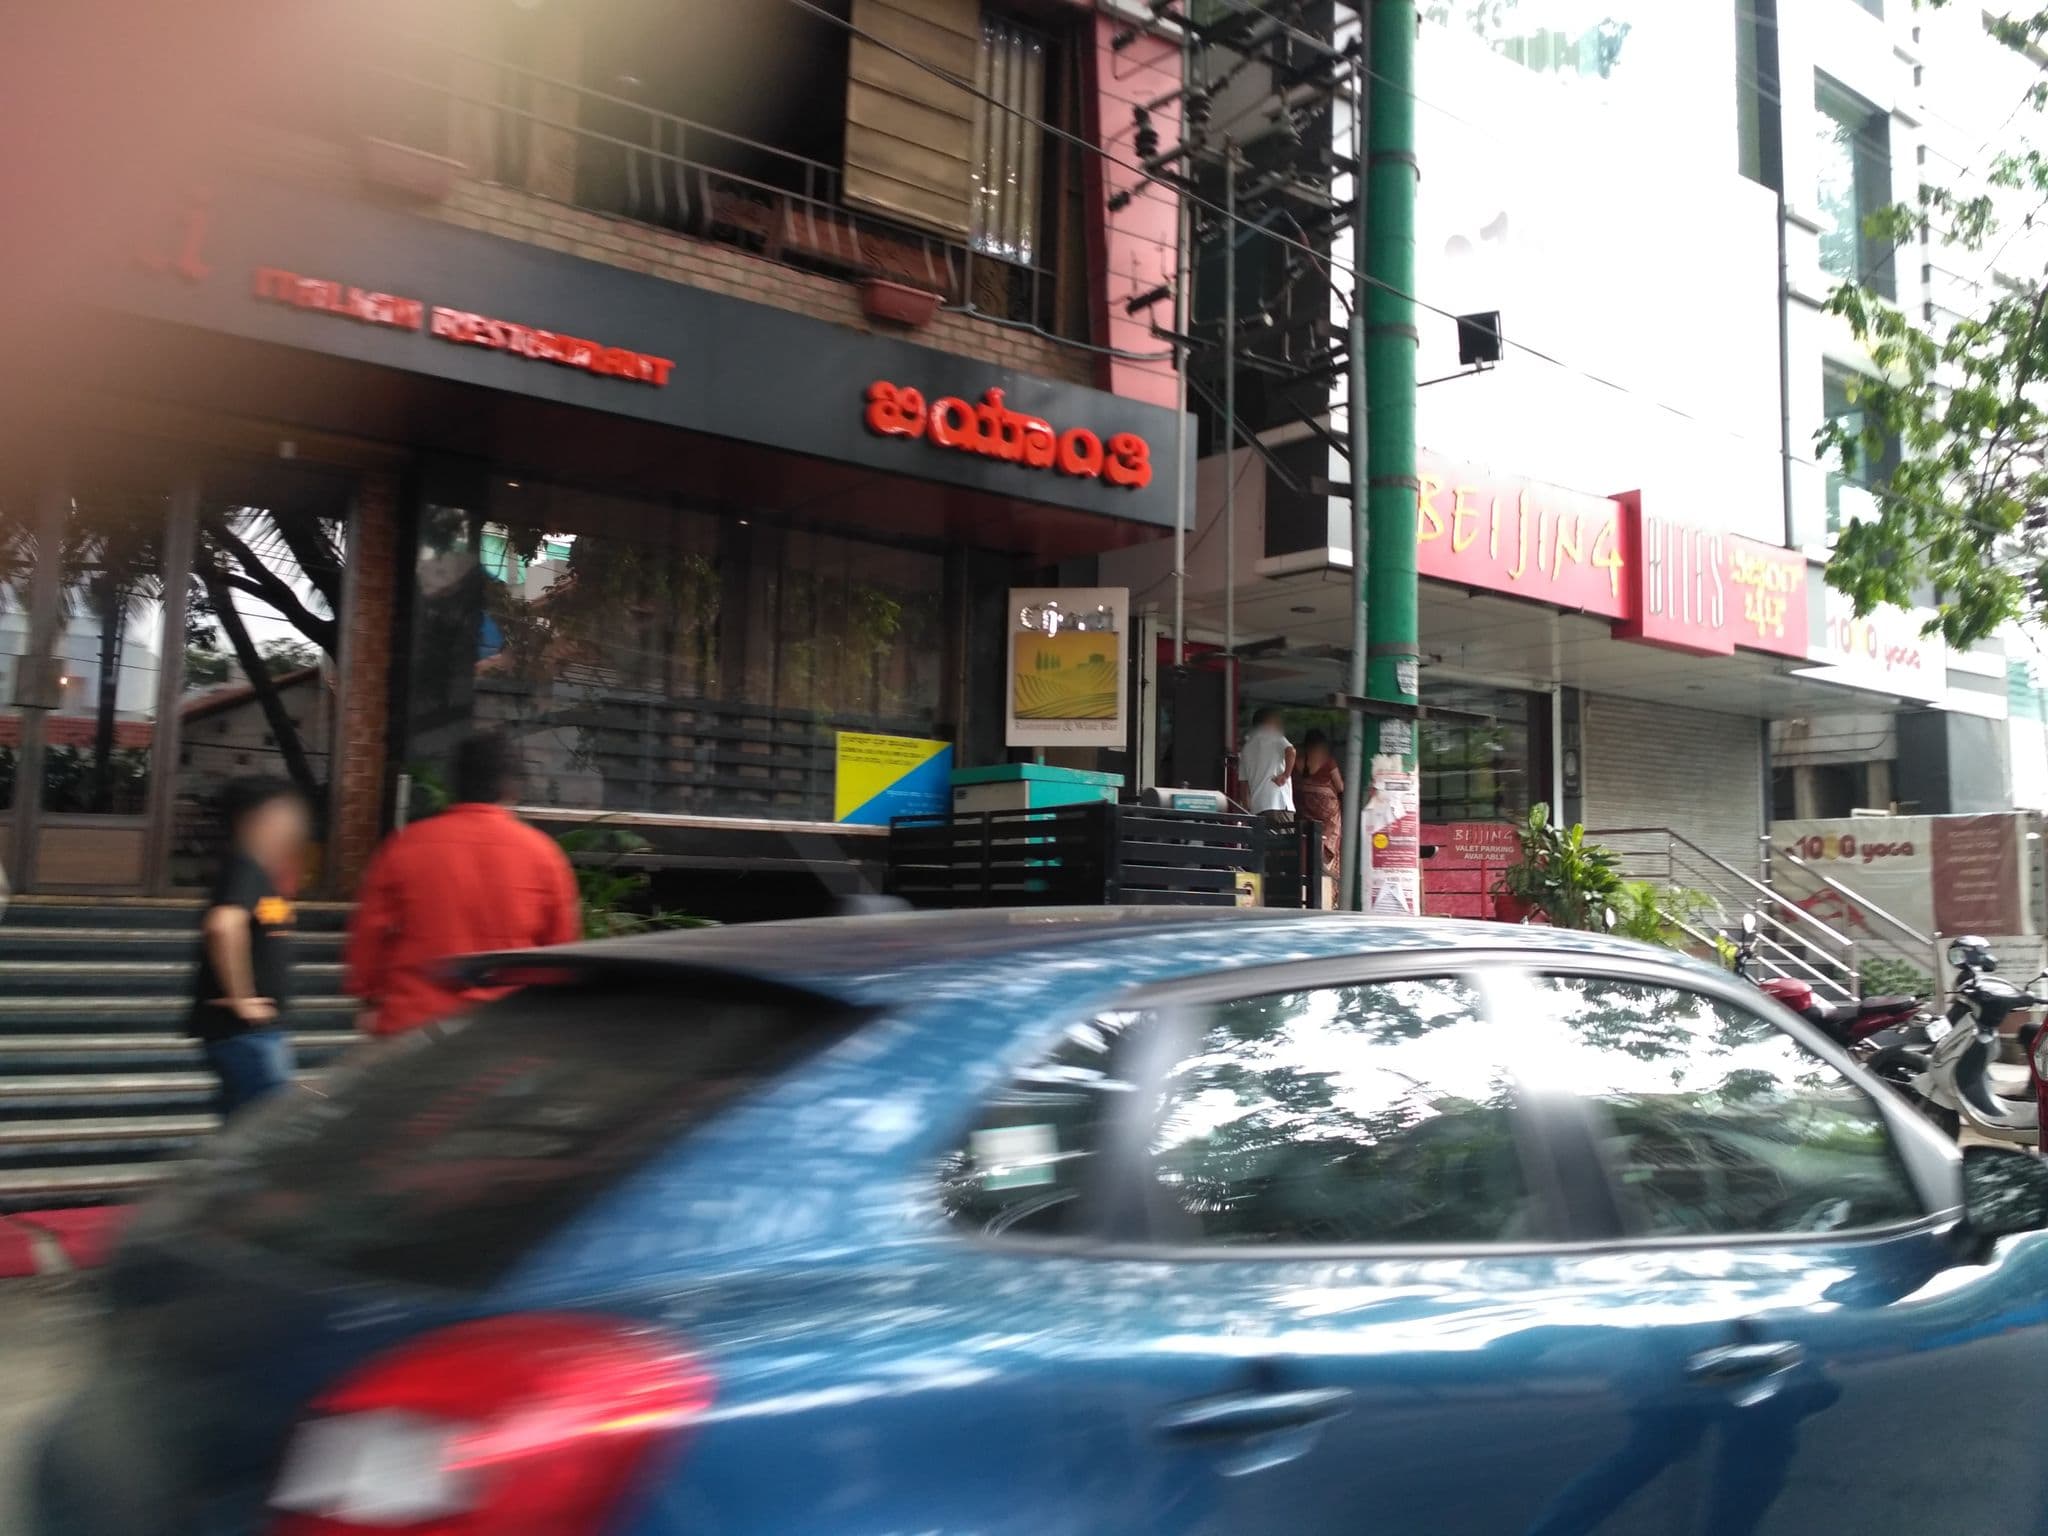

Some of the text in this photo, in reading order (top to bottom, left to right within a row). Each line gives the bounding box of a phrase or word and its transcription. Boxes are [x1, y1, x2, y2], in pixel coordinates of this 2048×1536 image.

[1418, 475, 1624, 597] BEIJING
[1453, 829, 1513, 844] BEIJING
[1455, 844, 1514, 854] VALET PARKING
[1464, 852, 1505, 861] AVAILABLE
